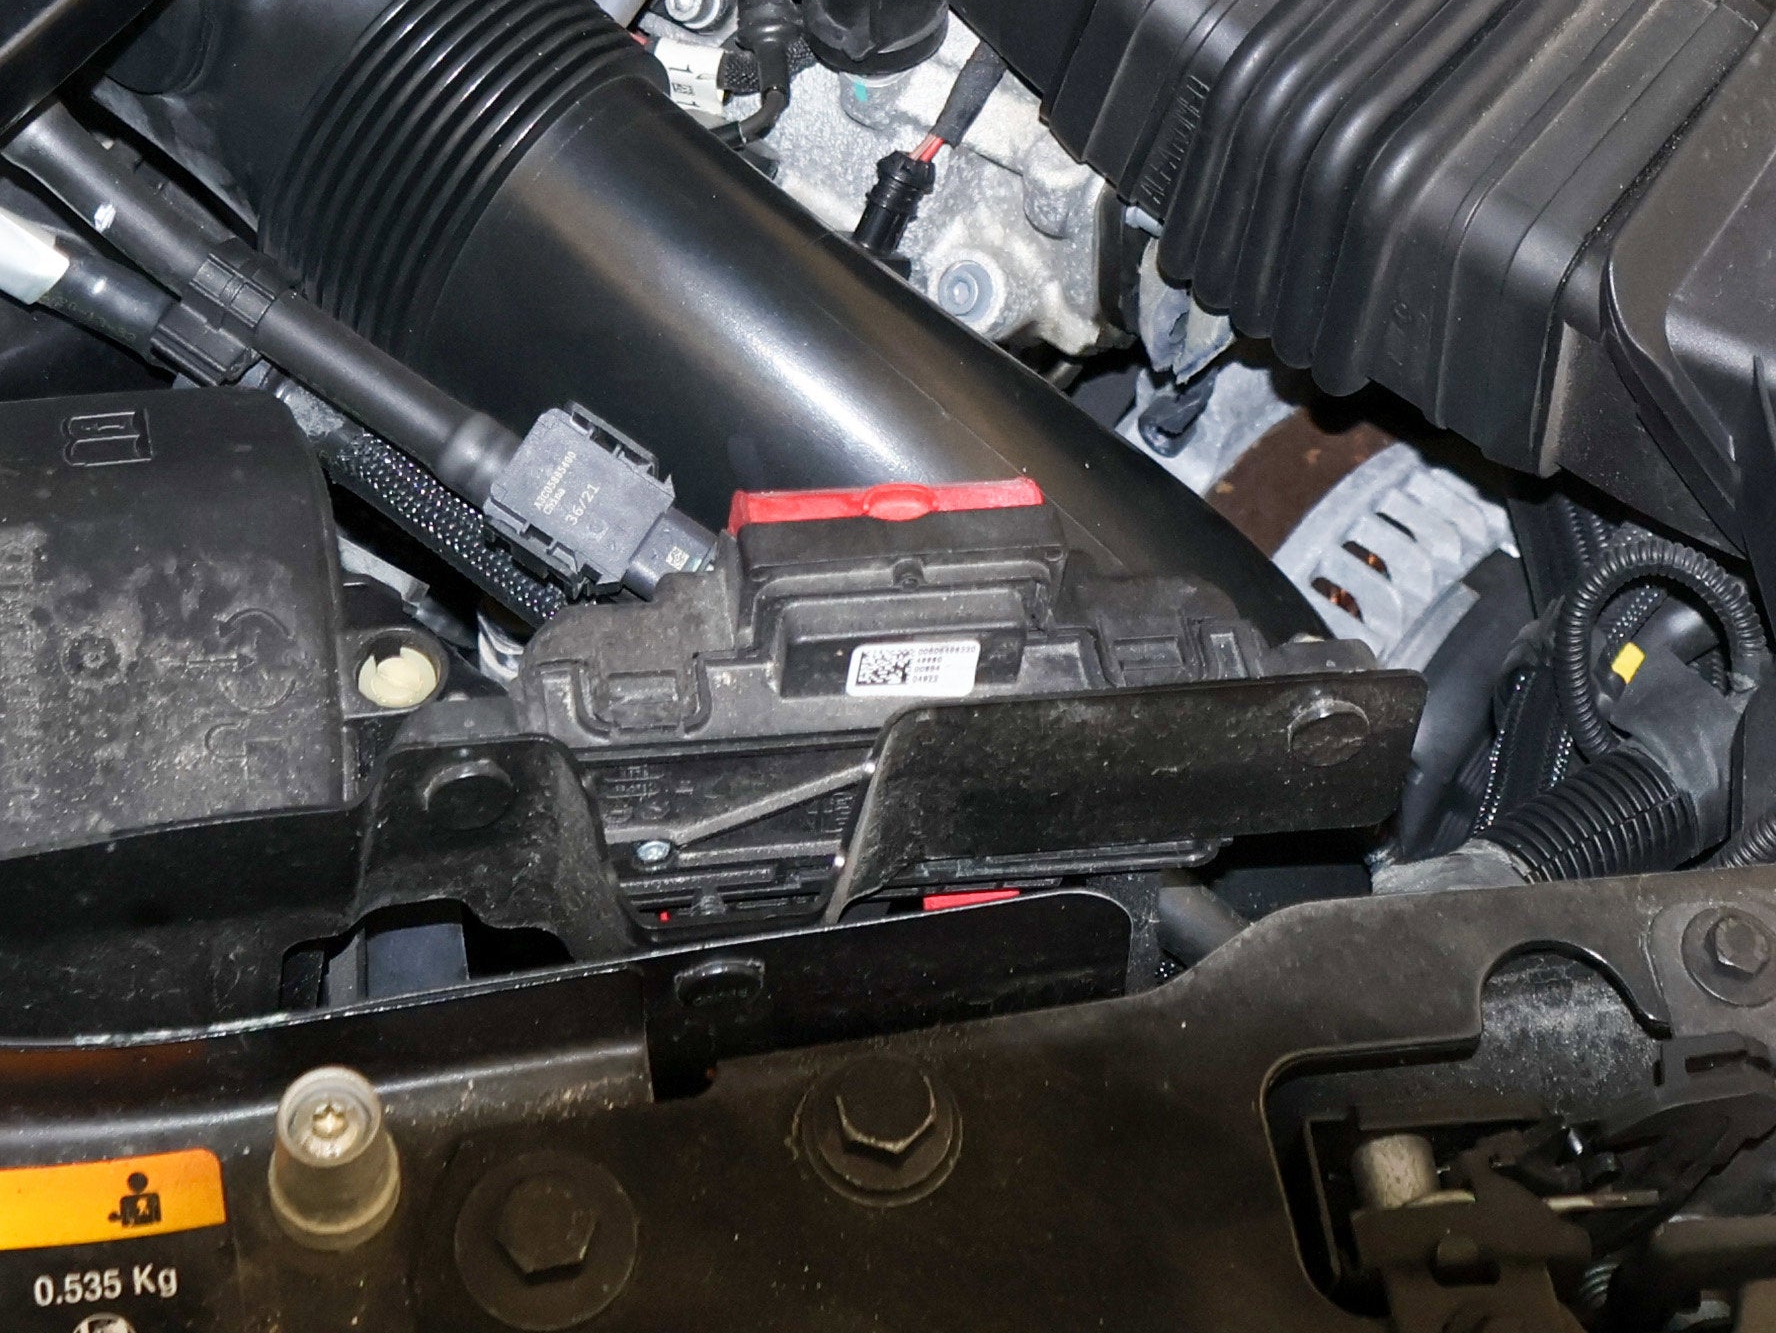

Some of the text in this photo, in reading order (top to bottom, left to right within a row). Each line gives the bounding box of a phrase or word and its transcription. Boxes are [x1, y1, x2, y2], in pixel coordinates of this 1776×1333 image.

[563, 480, 601, 528] 36/21
[33, 1264, 179, 1309] 0.535 Kg
